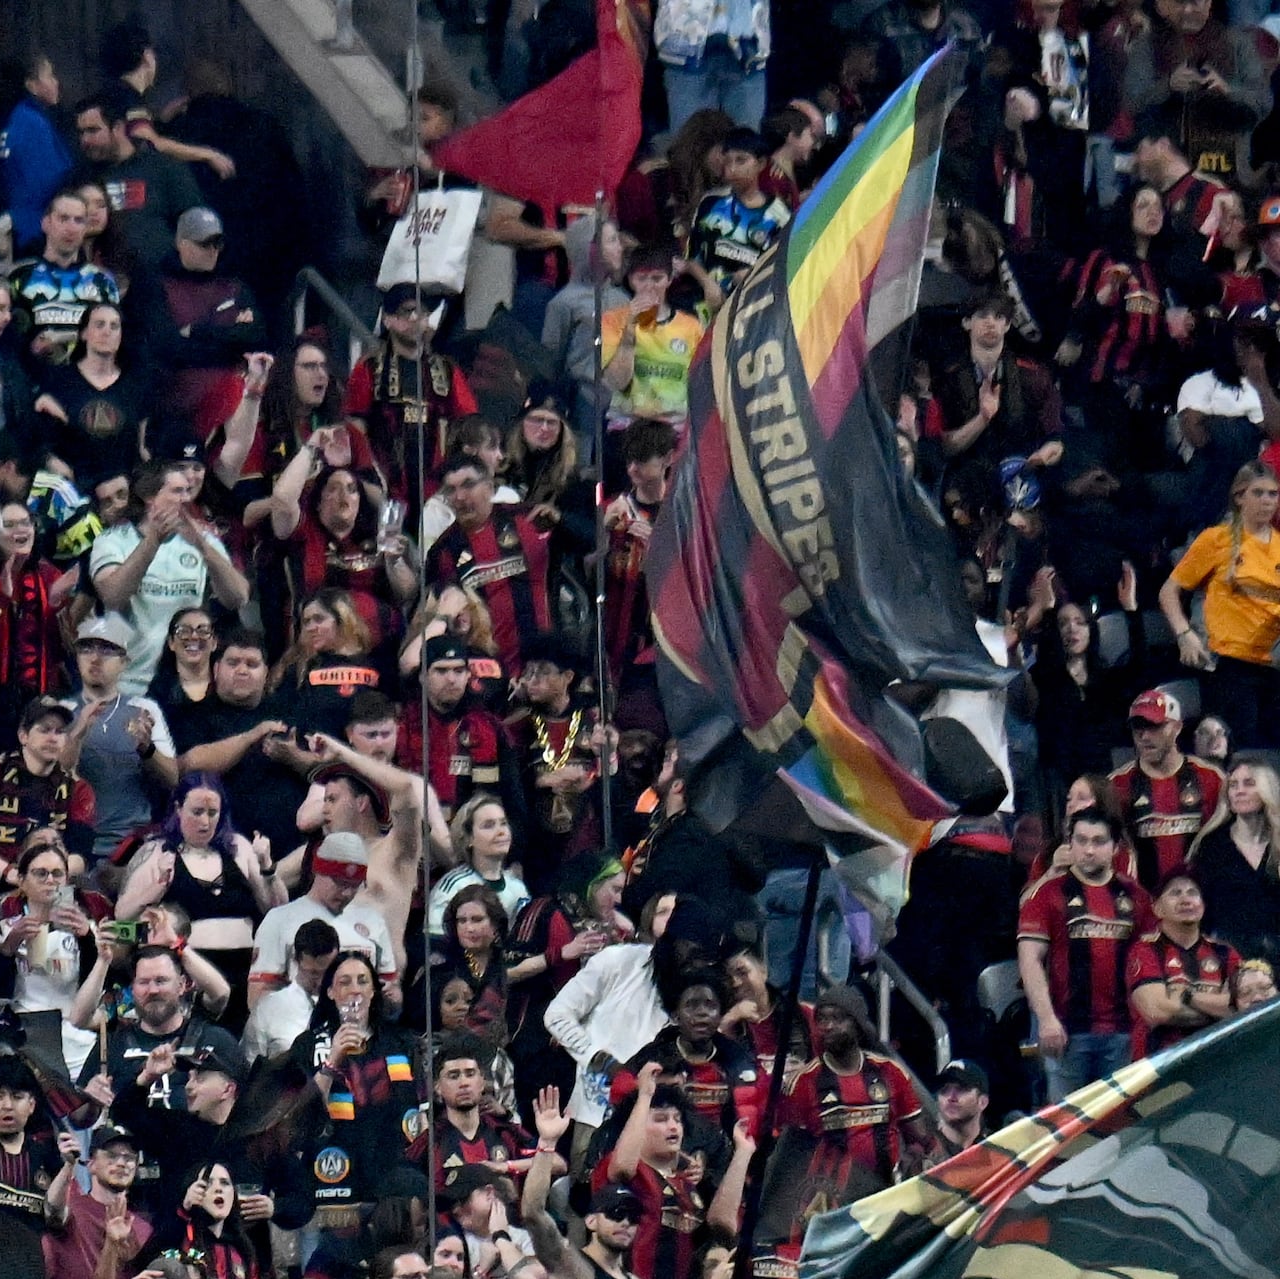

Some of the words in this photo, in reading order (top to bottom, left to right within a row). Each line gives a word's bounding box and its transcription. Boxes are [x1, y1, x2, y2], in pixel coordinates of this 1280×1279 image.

[1199, 153, 1232, 172] ATL
[736, 339, 842, 606] STRIPES
[315, 1187, 352, 1198] marta
